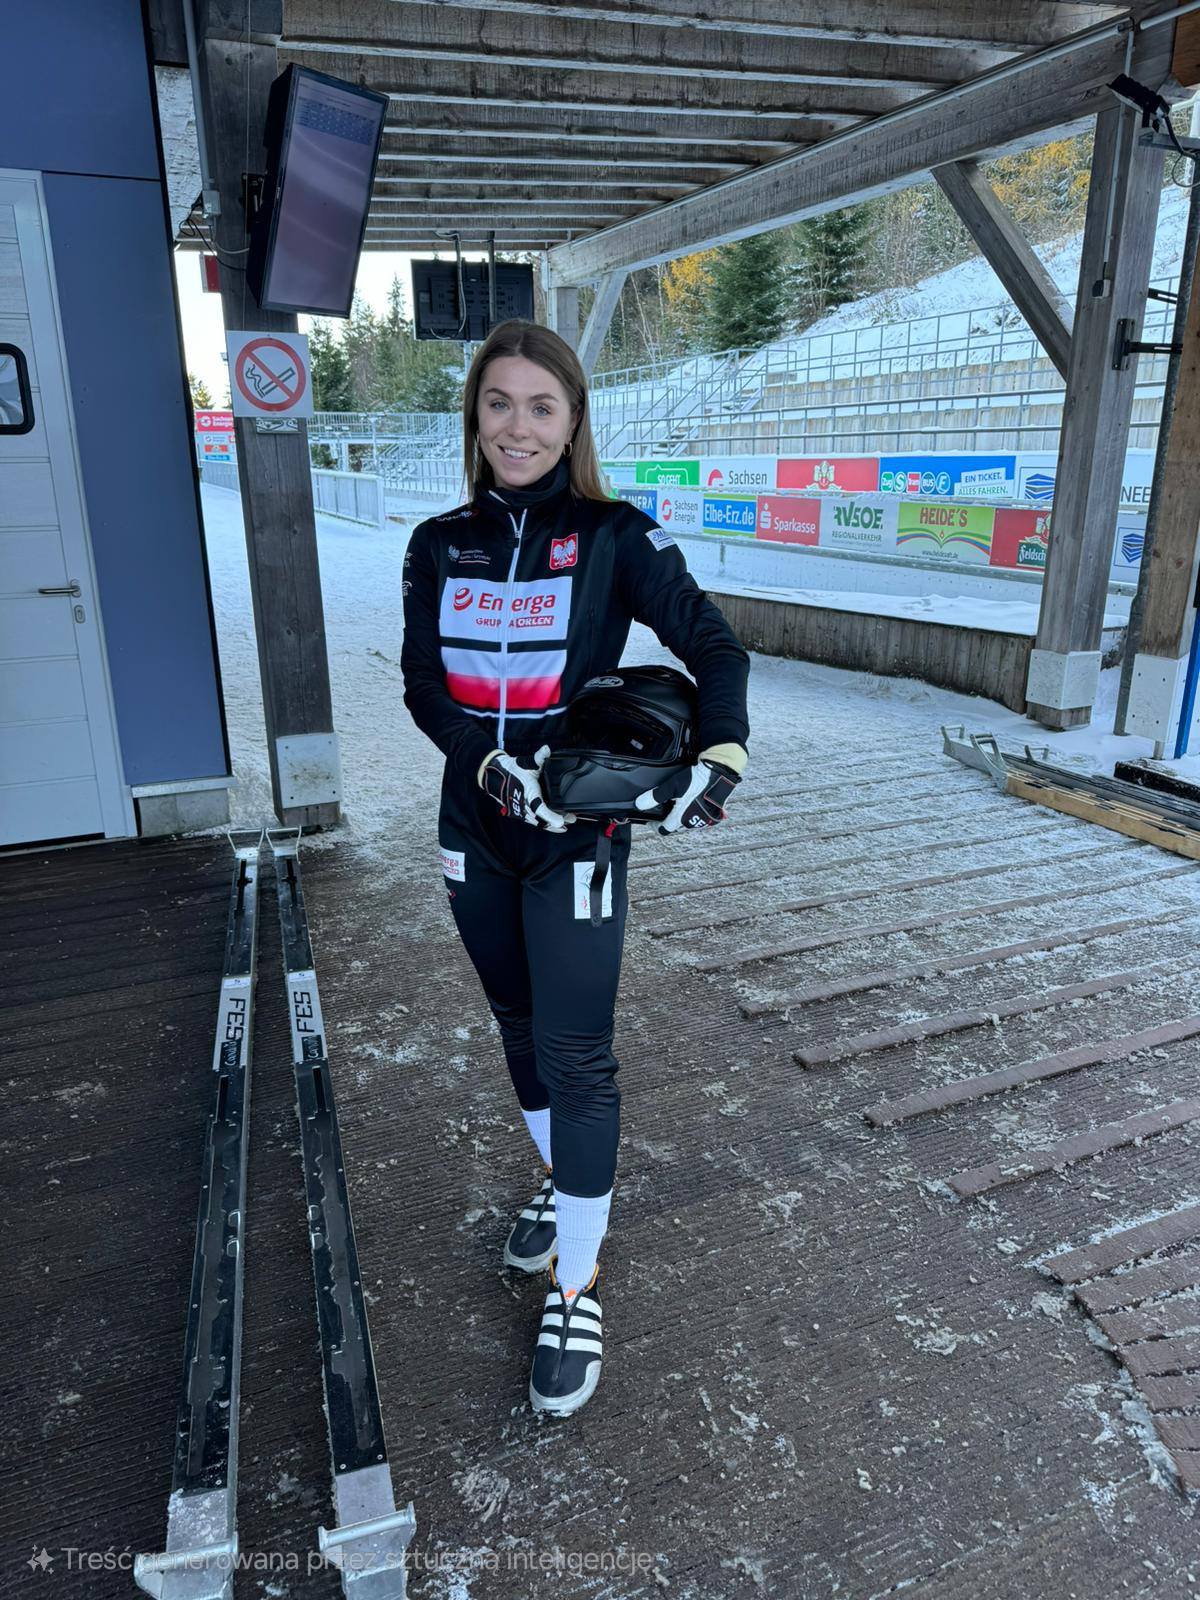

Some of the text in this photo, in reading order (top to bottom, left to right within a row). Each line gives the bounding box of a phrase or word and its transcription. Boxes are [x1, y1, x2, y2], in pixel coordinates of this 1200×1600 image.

[728, 471, 768, 485] Sachsen
[964, 475, 978, 484] EIN
[959, 485, 979, 496] ALLES
[674, 500, 698, 511] Sachsen
[674, 512, 696, 525] Energie
[704, 502, 755, 526] Elbe-Erz.de
[773, 516, 816, 534] Sparkasse
[832, 530, 882, 543] REGIONALVERKEHR
[478, 592, 556, 615] Energa
[516, 616, 554, 628] ORLEN
[293, 991, 315, 1033] FES
[225, 998, 246, 1040] FES
